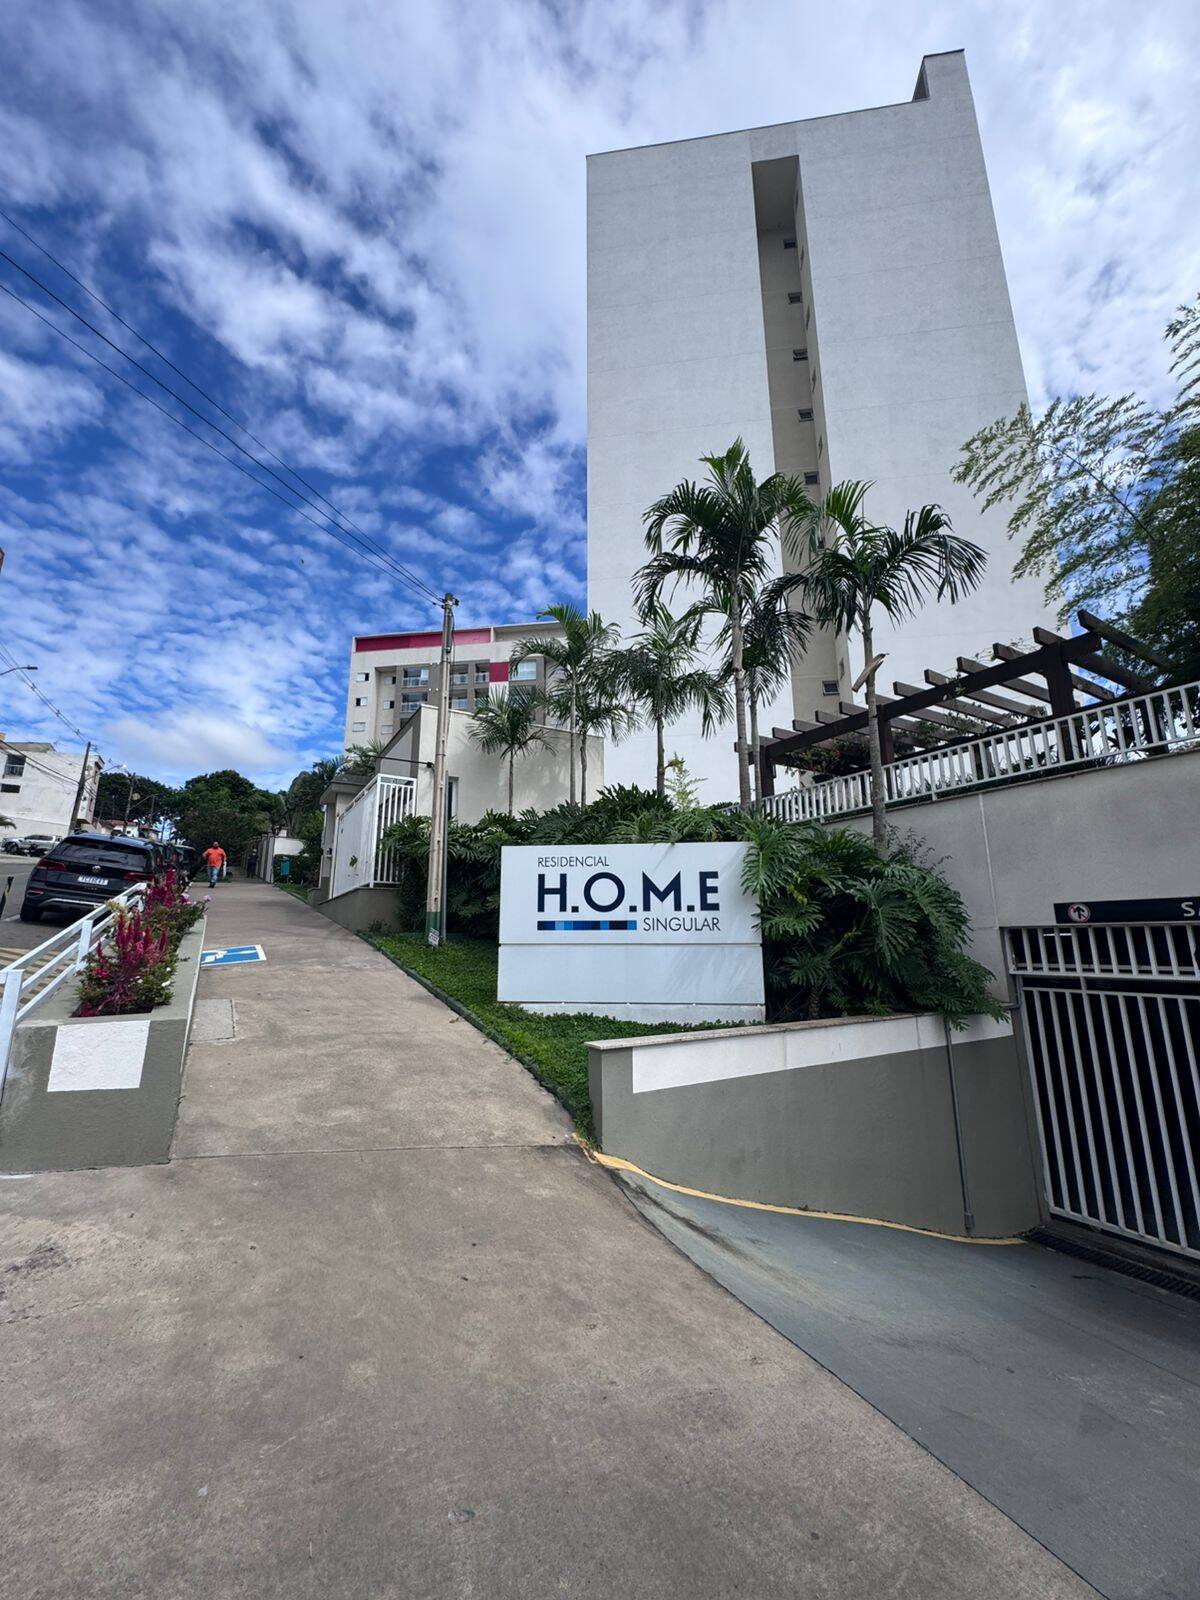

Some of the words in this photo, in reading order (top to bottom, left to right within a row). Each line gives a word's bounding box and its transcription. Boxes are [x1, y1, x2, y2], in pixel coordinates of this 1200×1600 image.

[537, 855, 610, 868] RESIDENCIAL
[537, 870, 720, 913] H.O.M.E
[643, 917, 721, 932] SINGULAR
